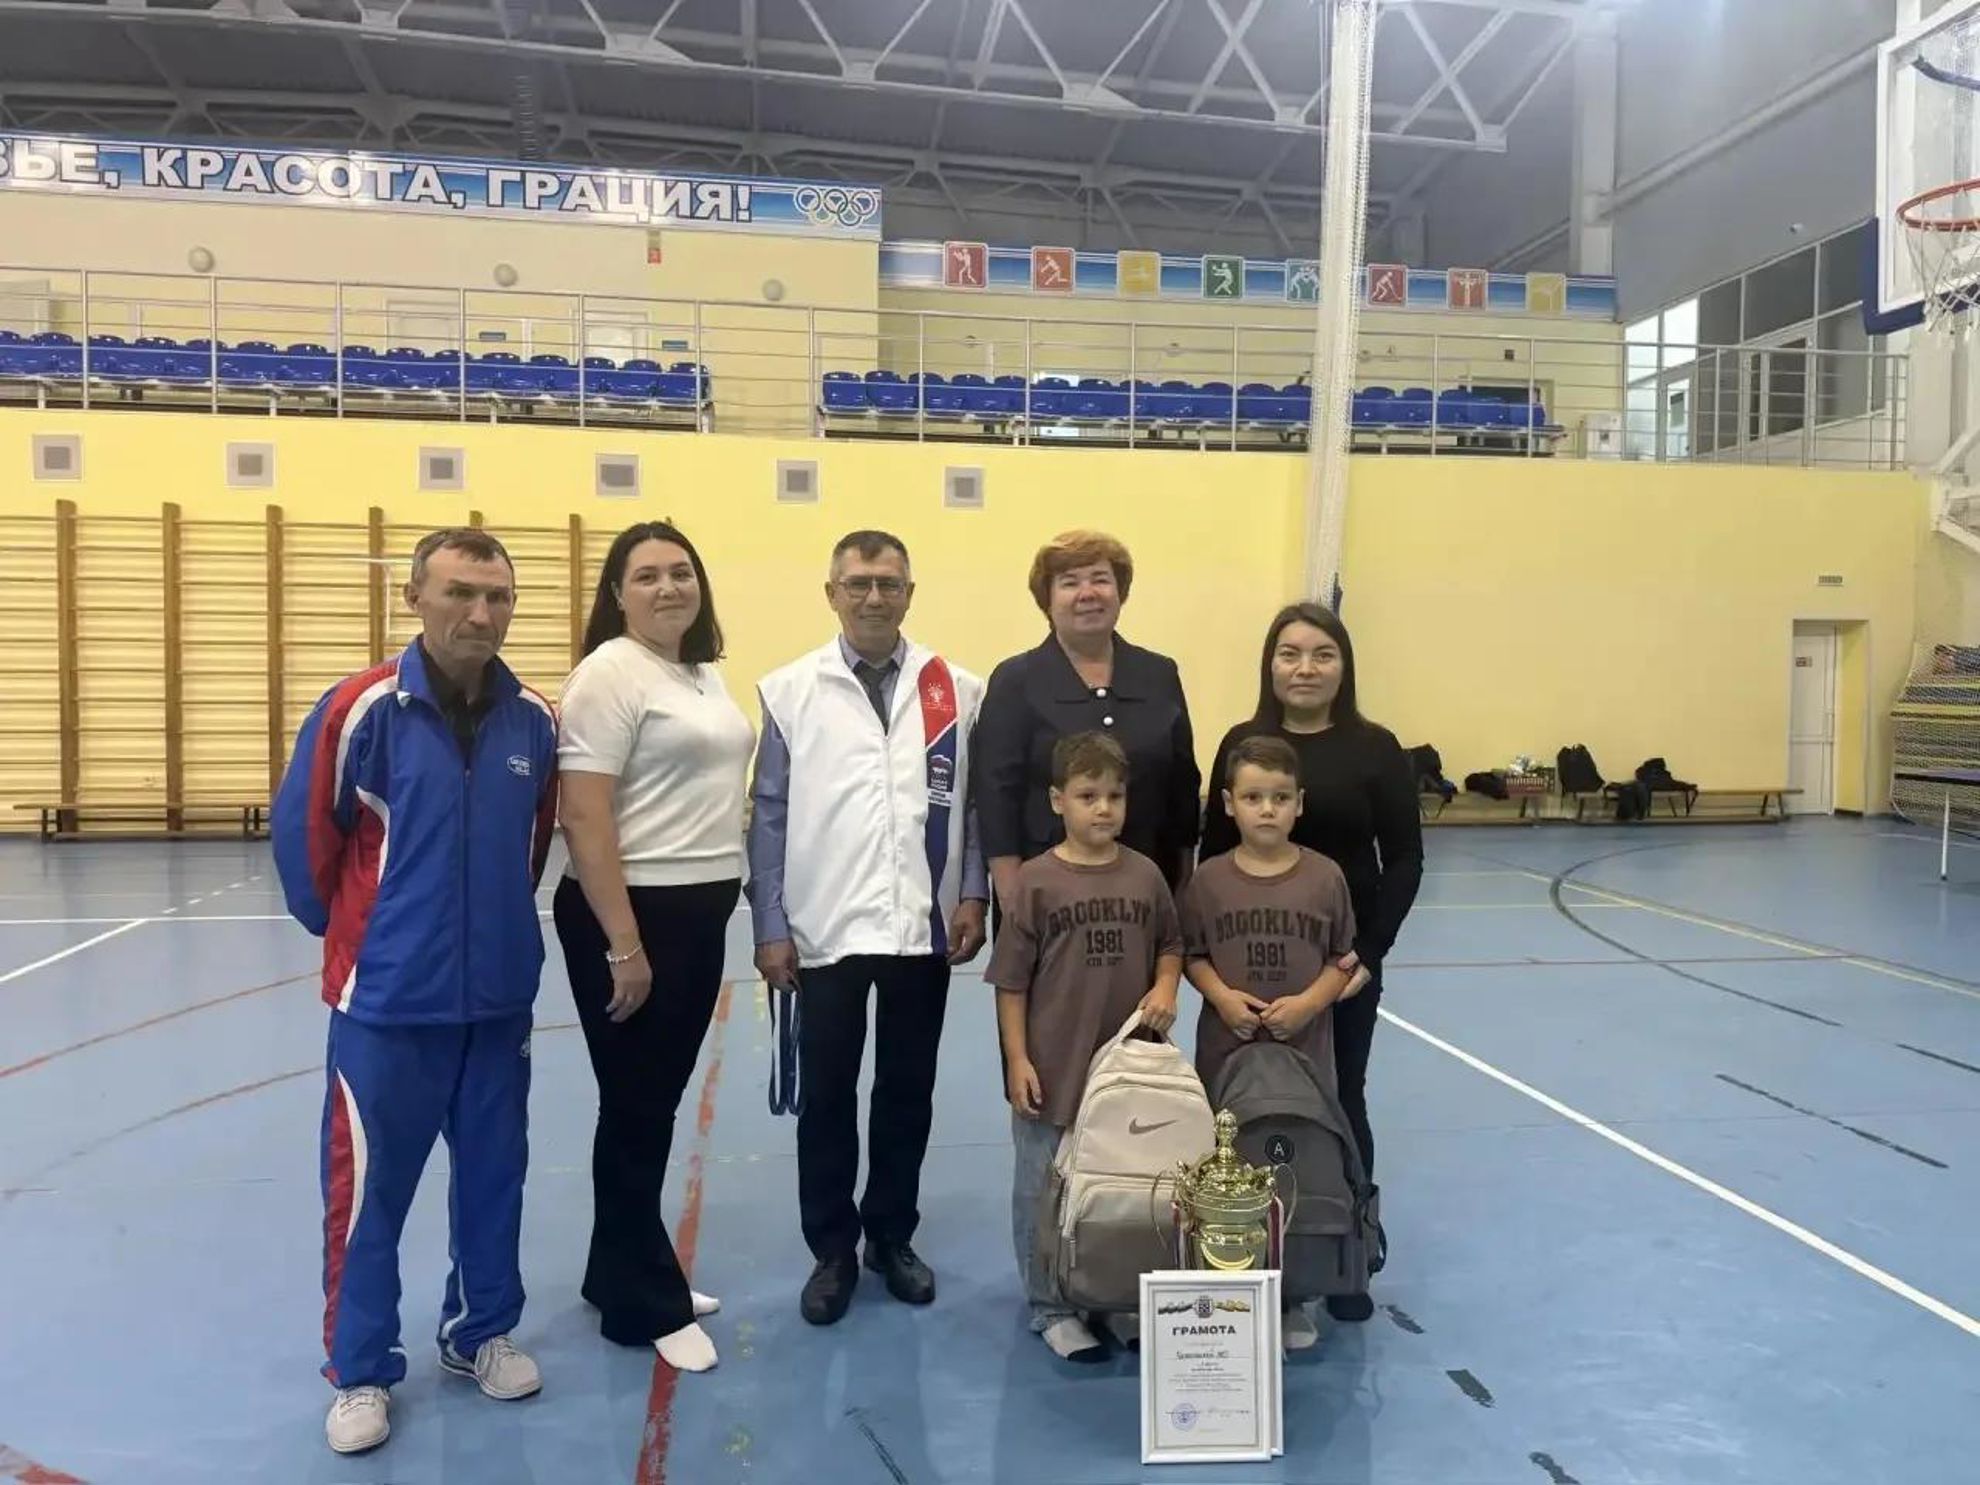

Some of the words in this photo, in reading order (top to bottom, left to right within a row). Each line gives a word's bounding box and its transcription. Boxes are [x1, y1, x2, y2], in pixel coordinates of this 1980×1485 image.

[0, 139, 121, 188] ЬЕ,
[140, 146, 466, 209] КРАСОТА,
[486, 168, 752, 222] ГРАЦИЯ!
[1087, 929, 1124, 954] 1981
[1172, 1325, 1236, 1336] ГРАМОТА
